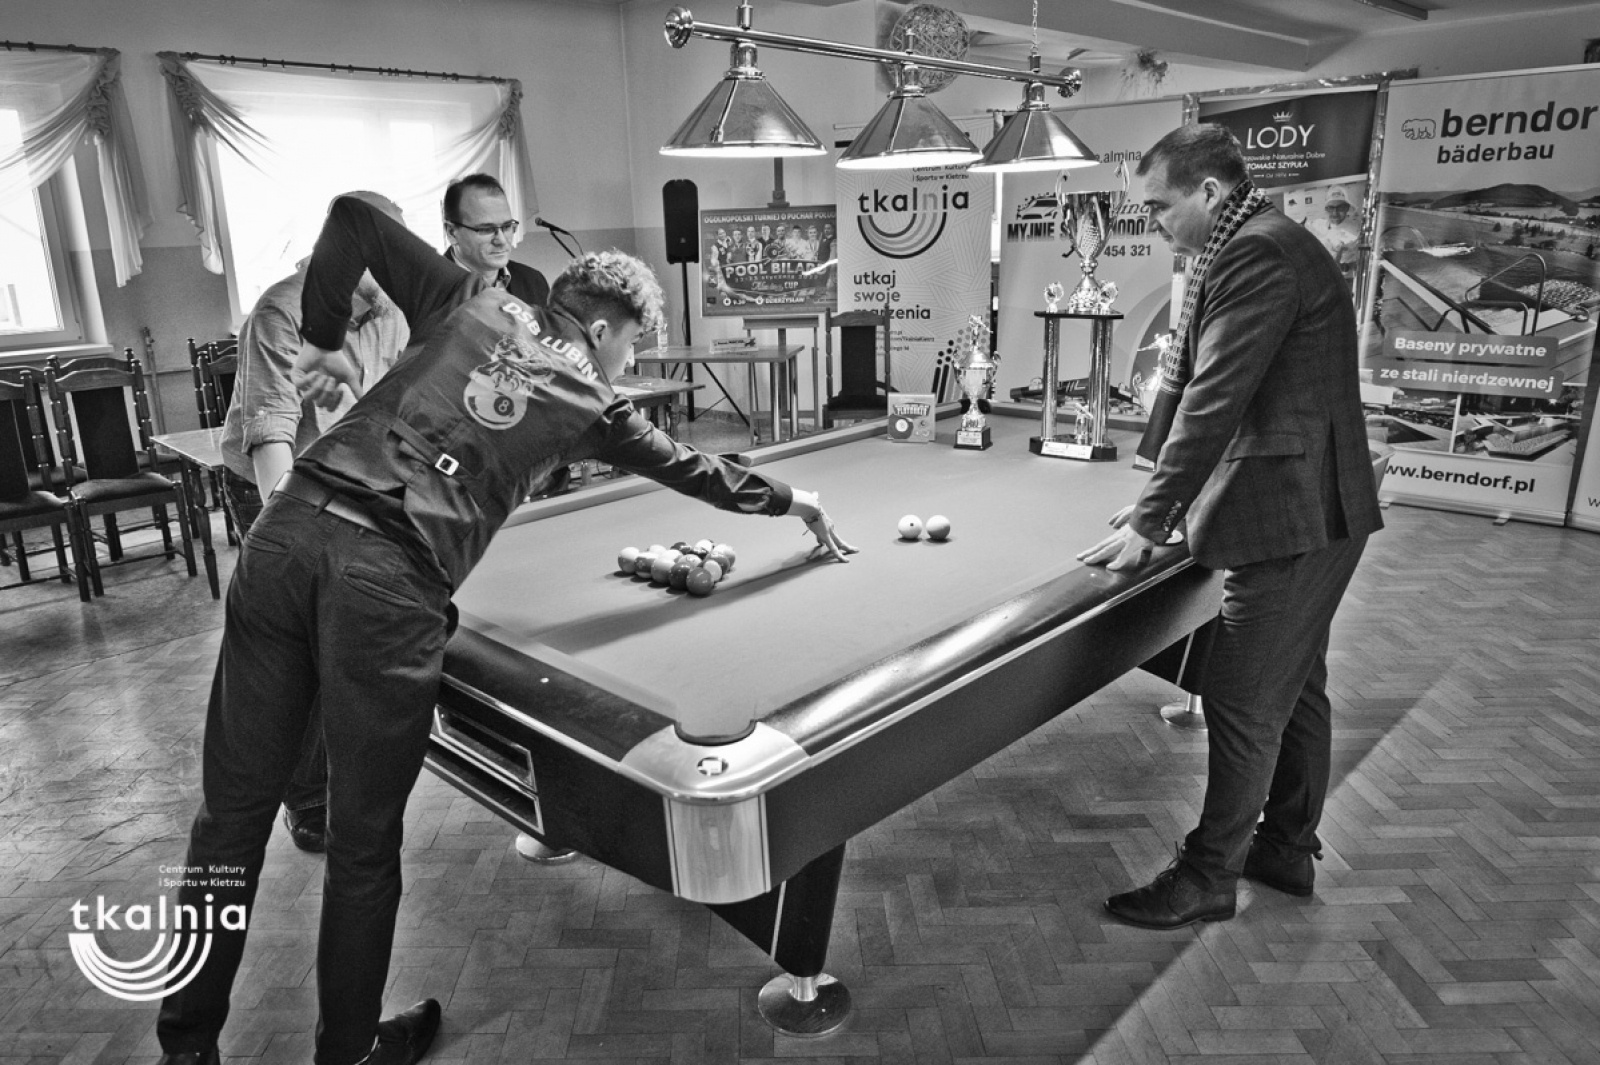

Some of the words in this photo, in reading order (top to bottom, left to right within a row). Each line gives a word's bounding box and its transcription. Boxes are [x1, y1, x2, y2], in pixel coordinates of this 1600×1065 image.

[1440, 101, 1599, 138] berndor
[1246, 124, 1315, 149] LODY
[1437, 142, 1555, 164] bäderbau
[1247, 162, 1276, 170] TOMASZ
[916, 173, 938, 182] Sportu
[858, 184, 969, 213] tkalnia
[1007, 222, 1054, 242] MYJNIE
[1104, 245, 1126, 257] 454
[1130, 244, 1151, 256] 321
[725, 263, 767, 278] POOL
[854, 270, 896, 288] utkaj
[854, 288, 901, 303] swoje
[502, 302, 541, 335] DSB
[540, 336, 598, 381] LUBIN
[1394, 337, 1455, 353] Baseny
[1458, 342, 1547, 357] prywatne
[1380, 369, 1400, 379] ze
[1402, 368, 1438, 382] stali
[1441, 370, 1555, 392] nierdzewnej
[498, 399, 509, 413] 8
[1385, 465, 1535, 493] ww.berndorf.pl
